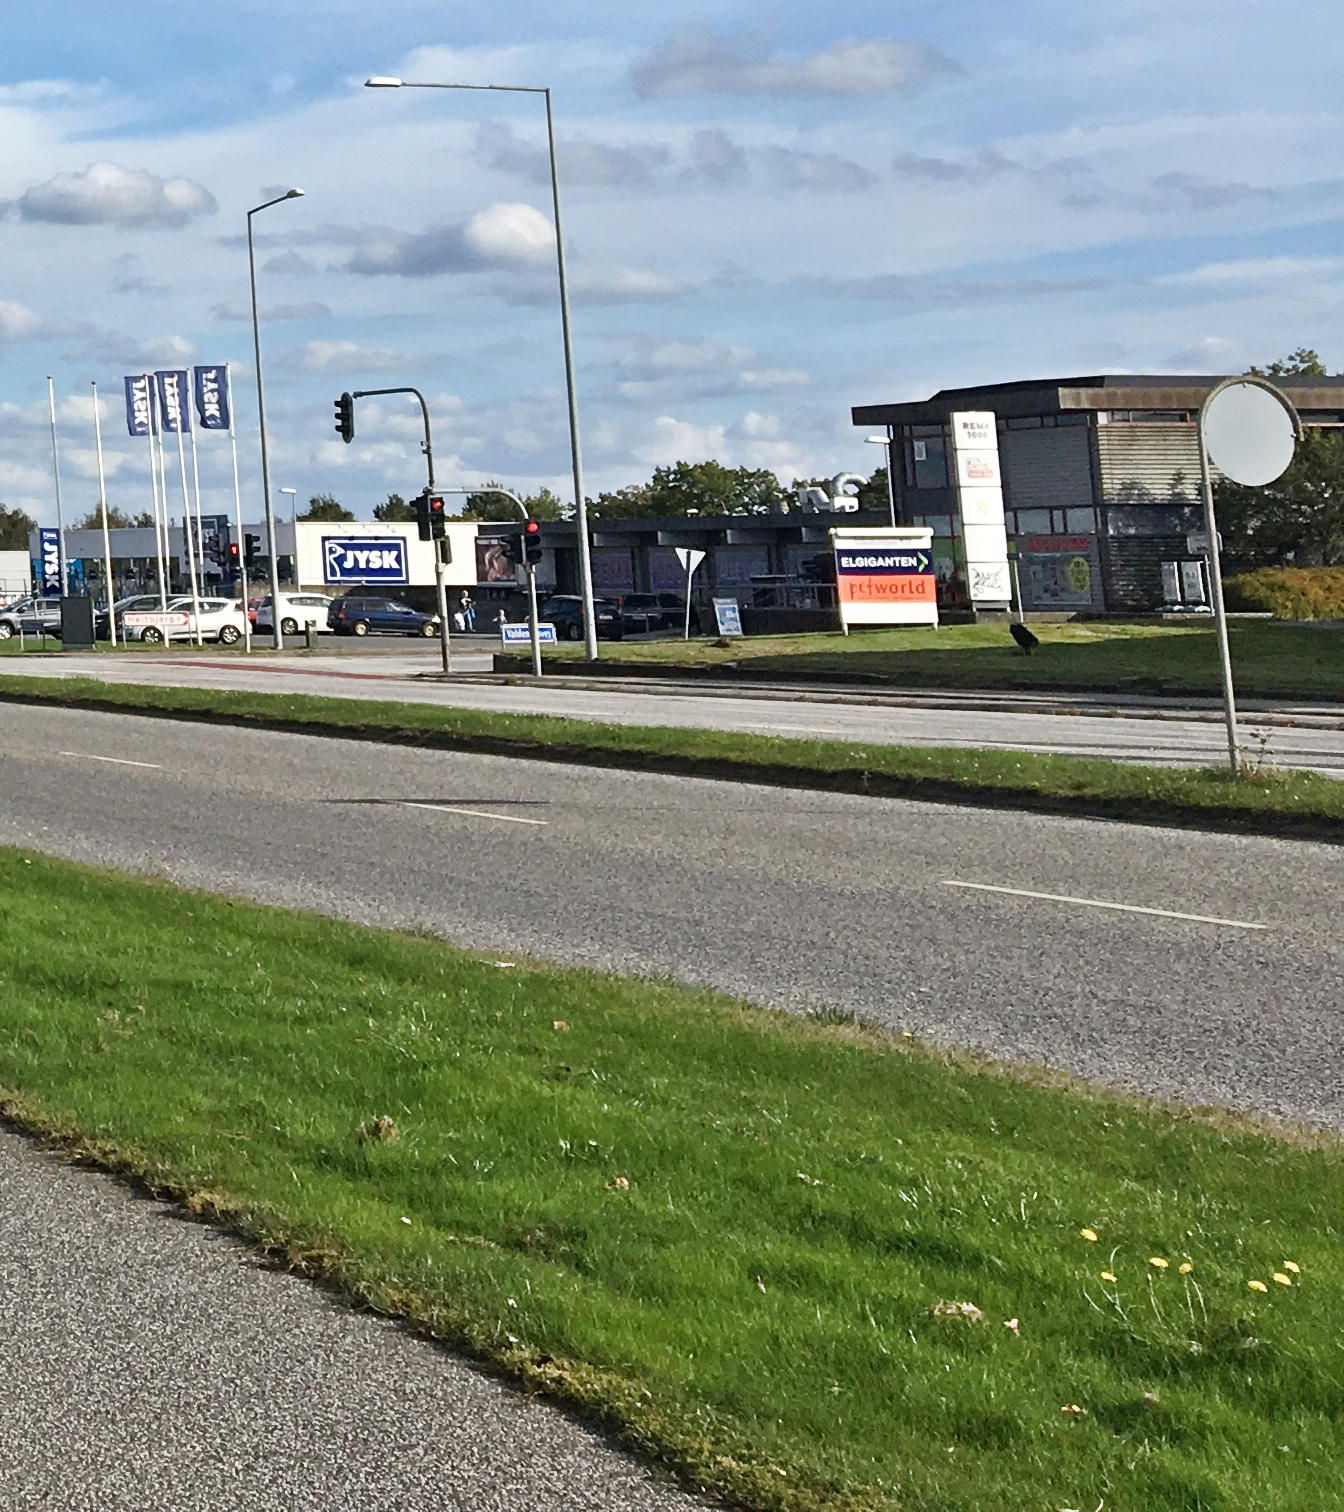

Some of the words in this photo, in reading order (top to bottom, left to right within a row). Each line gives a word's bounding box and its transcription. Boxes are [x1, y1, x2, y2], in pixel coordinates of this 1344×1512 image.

[43, 542, 60, 588] JYSK
[342, 550, 401, 569] JYSK
[840, 556, 918, 567] ELGIGANTEN
